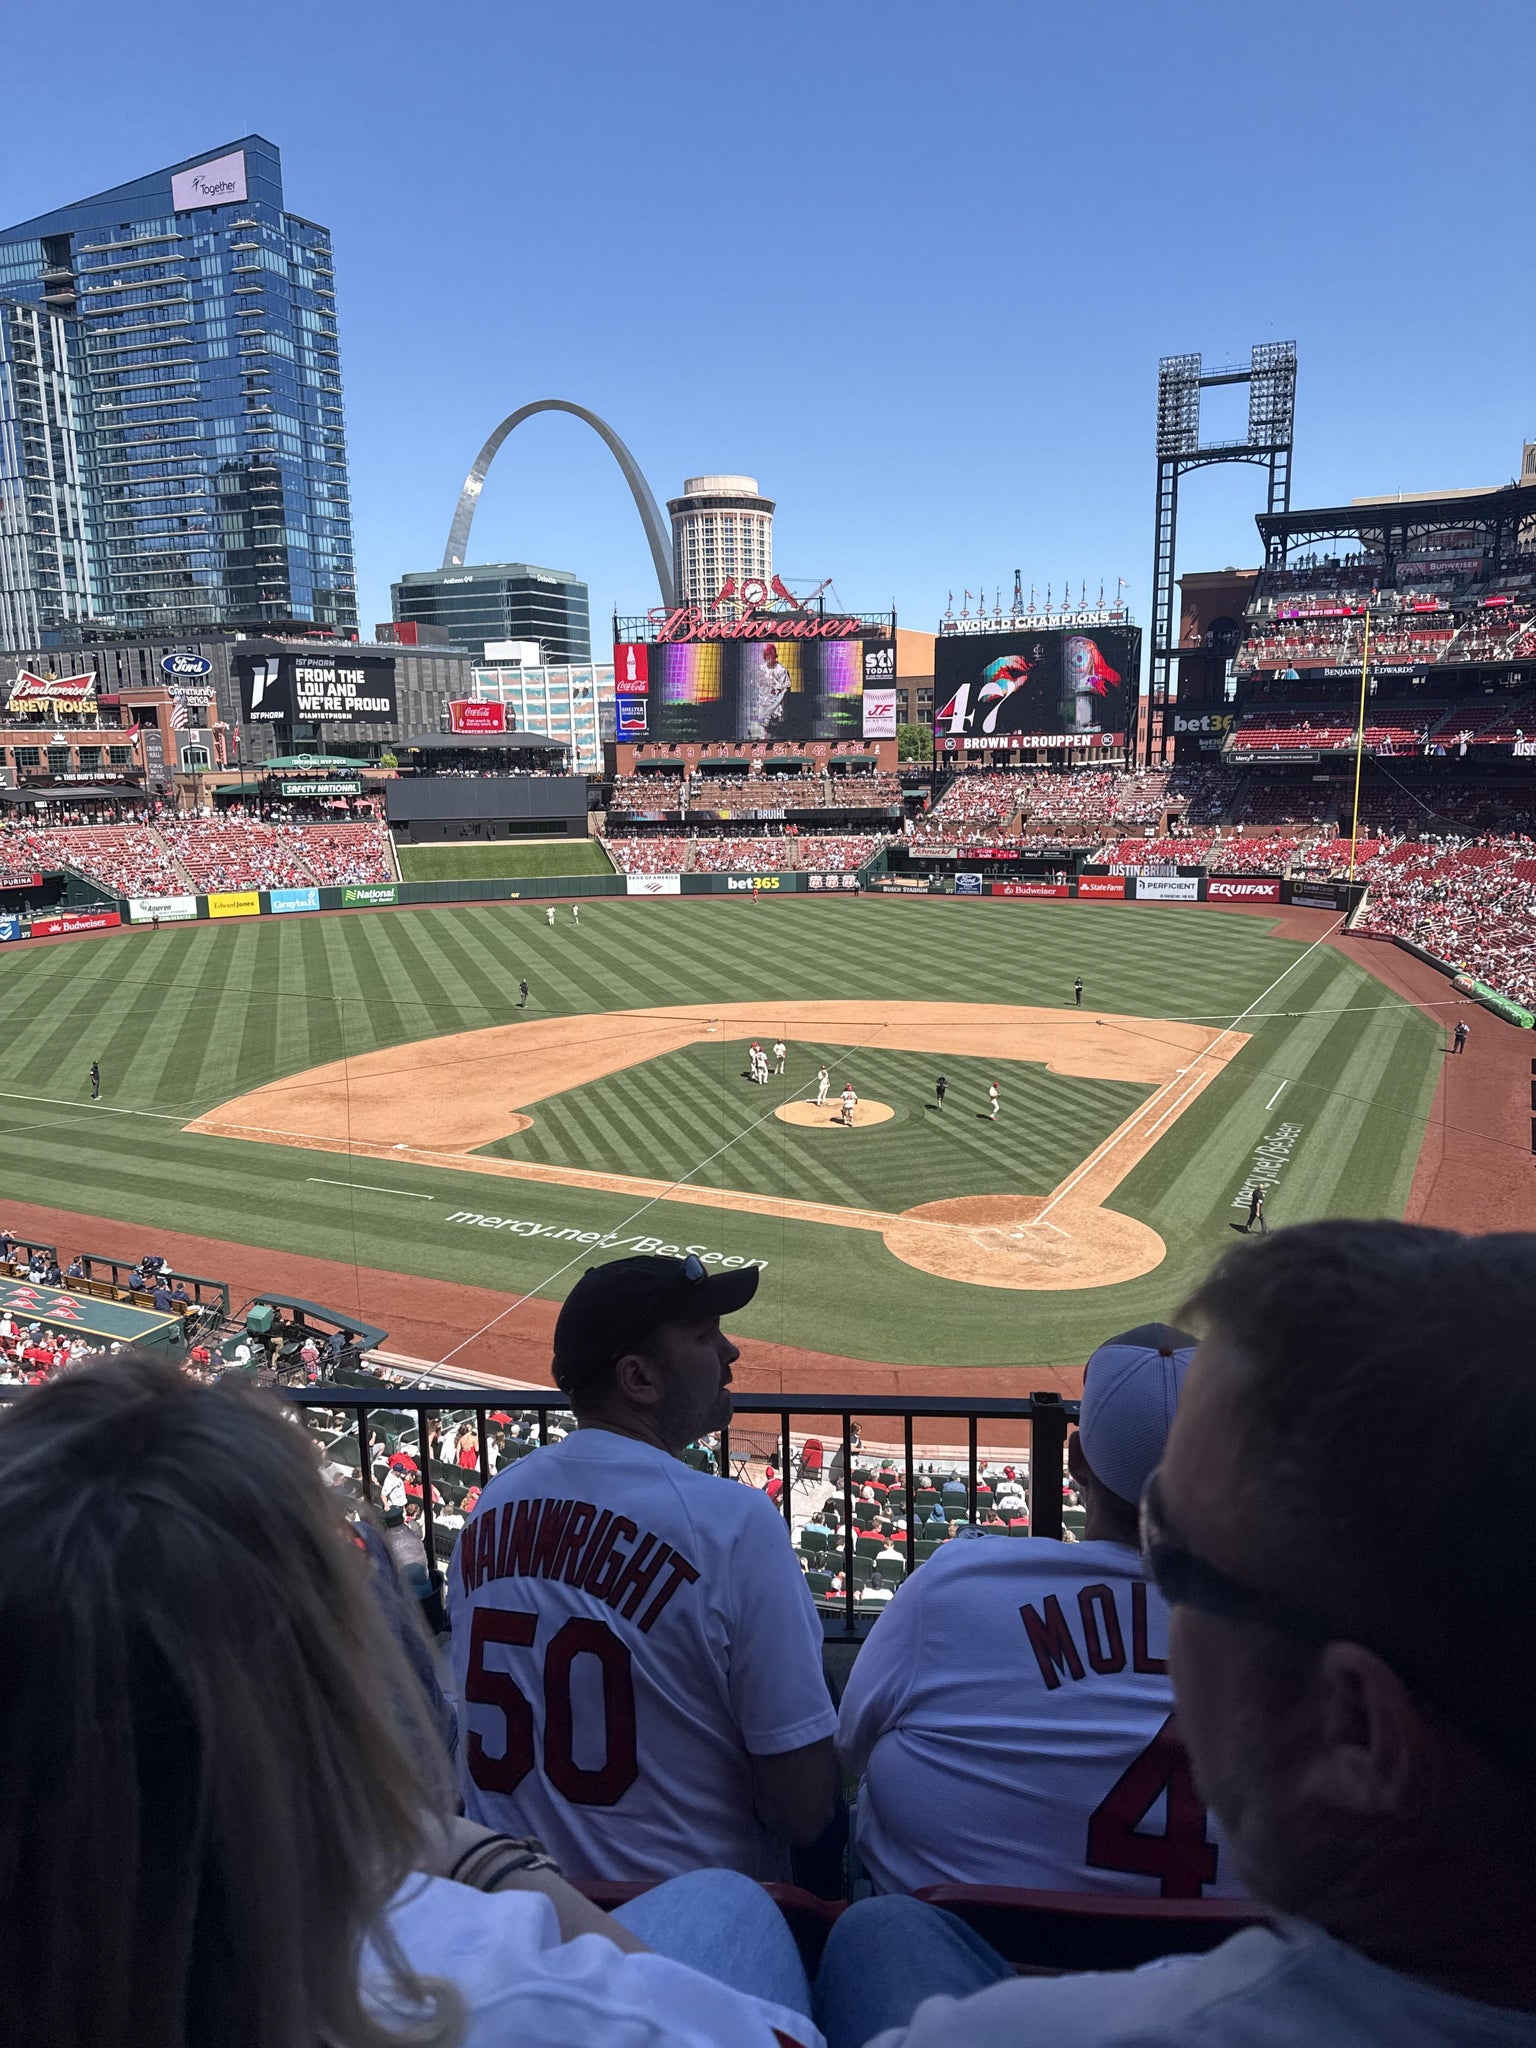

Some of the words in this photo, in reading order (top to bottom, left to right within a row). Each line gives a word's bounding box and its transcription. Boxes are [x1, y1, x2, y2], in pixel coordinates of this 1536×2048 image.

[200, 181, 236, 196] Together
[648, 607, 862, 644] Budweiser
[956, 618, 1011, 632] WORLD
[1014, 612, 1110, 628] CHAMPIONS
[172, 656, 203, 673] Ford
[865, 648, 894, 668] stl
[295, 668, 335, 683] FROM
[338, 669, 366, 684] THE
[1272, 668, 1287, 680] 47
[1374, 664, 1414, 674] EDWARDS
[7, 680, 95, 696] Budweiser
[297, 682, 325, 696] LOU
[327, 683, 357, 697] AND
[9, 700, 49, 713] BREW
[53, 701, 98, 713] HOUSE
[297, 697, 342, 710] WE'RE
[345, 698, 390, 711] PROUD
[936, 682, 1015, 734] 47
[1174, 715, 1234, 732] bet36
[964, 736, 1008, 749] BROWN
[1012, 739, 1019, 748] &
[1023, 734, 1091, 748] CROUPPEN
[661, 748, 668, 758] 2
[687, 747, 695, 758] 9
[752, 746, 766, 757] 20
[812, 745, 826, 756] 42
[287, 785, 315, 793] SAFETY
[318, 784, 357, 792] NATIONAL
[1108, 865, 1142, 876] JUSTIN
[728, 877, 780, 889] bet365
[1209, 883, 1274, 896] EQUIFAX
[357, 889, 395, 899] National
[1016, 887, 1056, 895] Budweiser
[147, 904, 172, 913] Ameren
[63, 920, 105, 931] Budweiser
[445, 1201, 768, 1272] mercy.net/BeSeen
[461, 1498, 700, 1634] WAINWRIGHT
[1019, 1582, 1169, 1690] MOL
[465, 1607, 639, 1806] 50
[1085, 1712, 1219, 1897] 4
